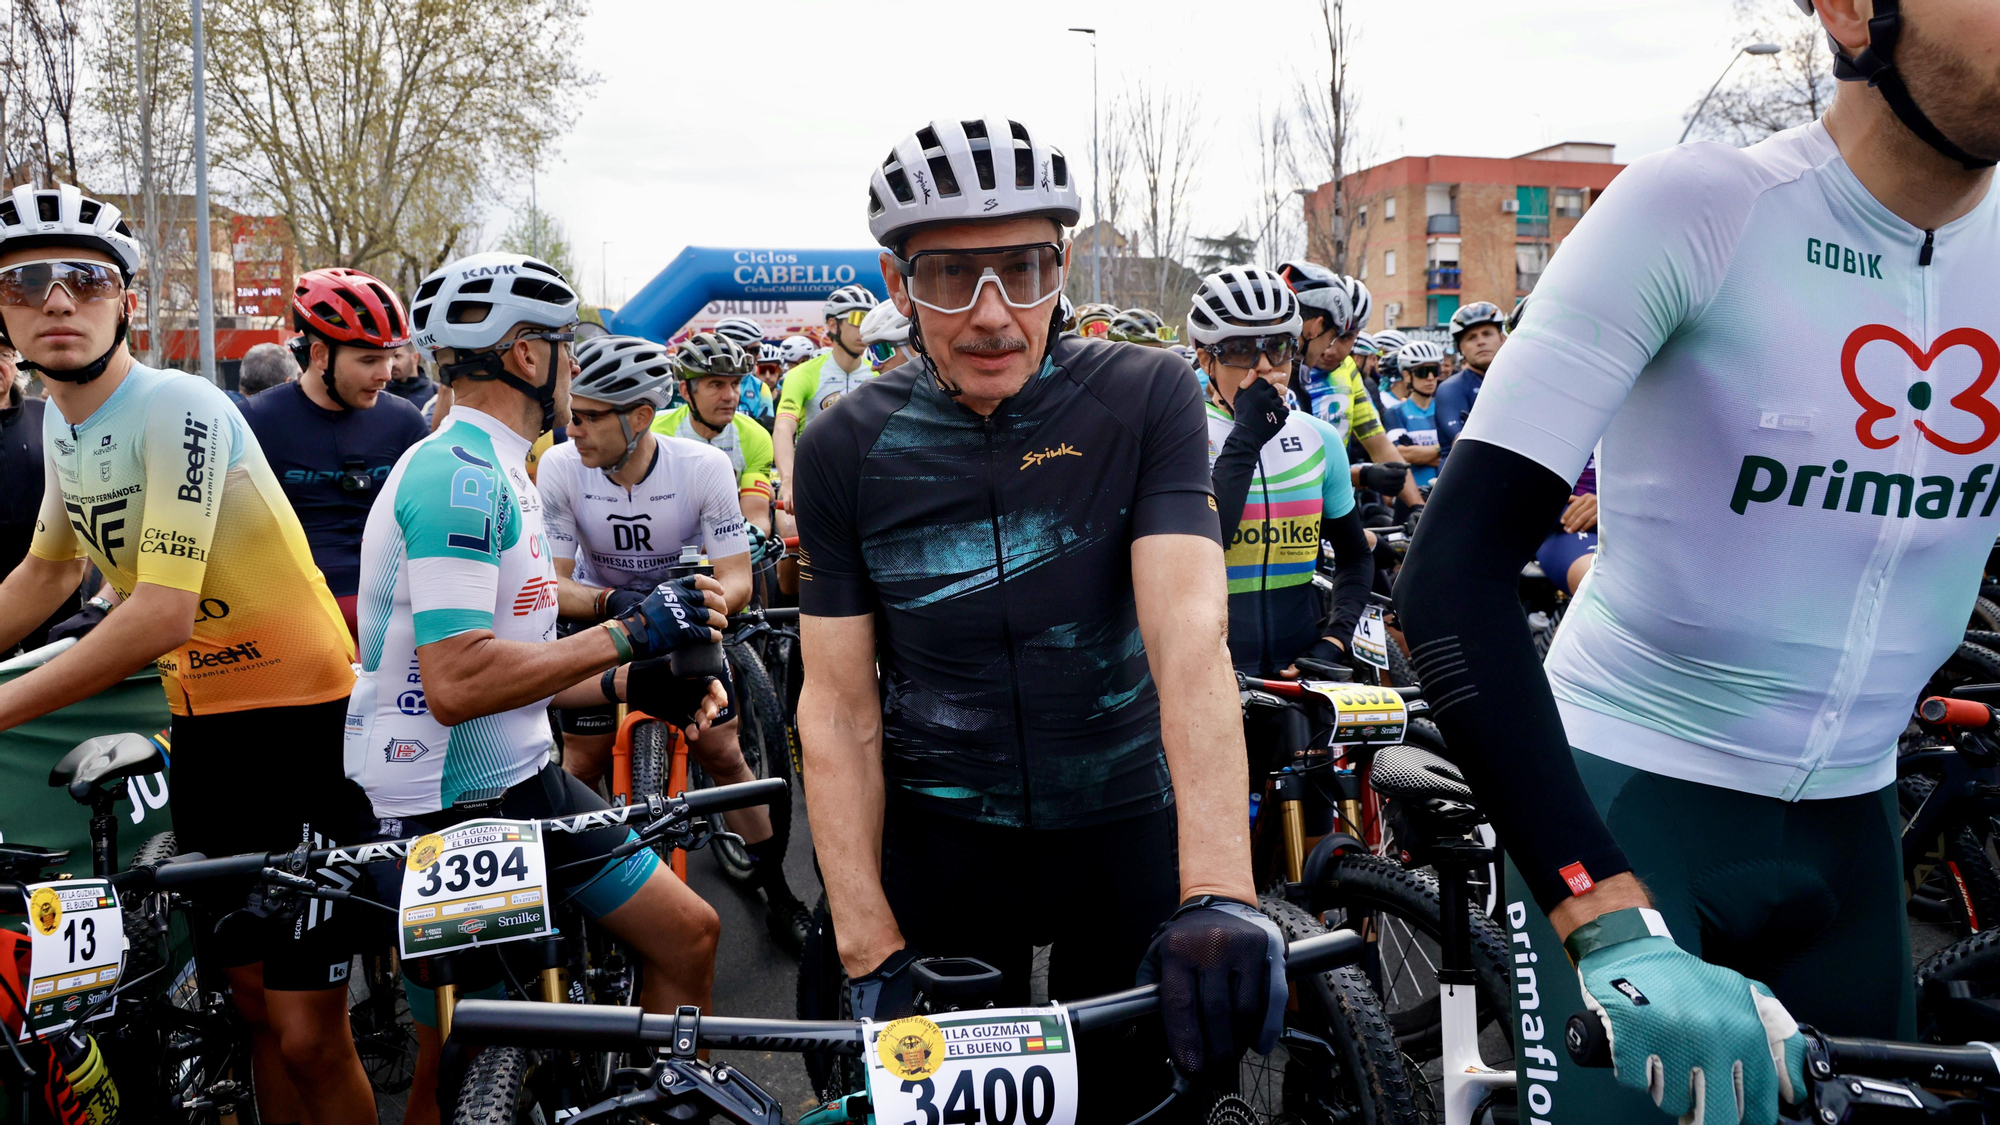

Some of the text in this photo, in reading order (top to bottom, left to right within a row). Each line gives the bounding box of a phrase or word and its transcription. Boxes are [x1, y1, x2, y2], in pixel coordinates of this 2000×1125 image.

[734, 251, 797, 264] Ciclos
[1806, 237, 1884, 280] GOBIK
[462, 265, 518, 280] KASK
[734, 265, 856, 284] CABELLO
[708, 300, 788, 315] SALIDA
[1020, 443, 1082, 470] Spiuk
[144, 528, 196, 545] Ciclos
[613, 524, 654, 551] DR
[657, 584, 690, 630] valsir
[456, 828, 468, 838] LA
[469, 824, 511, 835] GUZMÁN
[452, 835, 497, 848] EL BUENO
[417, 846, 528, 897] 3394
[1568, 872, 1588, 888] RAIN
[1580, 880, 1592, 891] LAB
[66, 900, 94, 910] EL BUENO
[498, 911, 540, 928] Smilke
[64, 917, 96, 963] 13
[880, 1016, 939, 1042] CAJÓN PREFERENTE
[952, 1029, 969, 1040] LA
[972, 1023, 1030, 1037] GUZMÁN
[949, 1041, 1012, 1056] EL BUENO
[900, 1064, 1055, 1125] 3400
